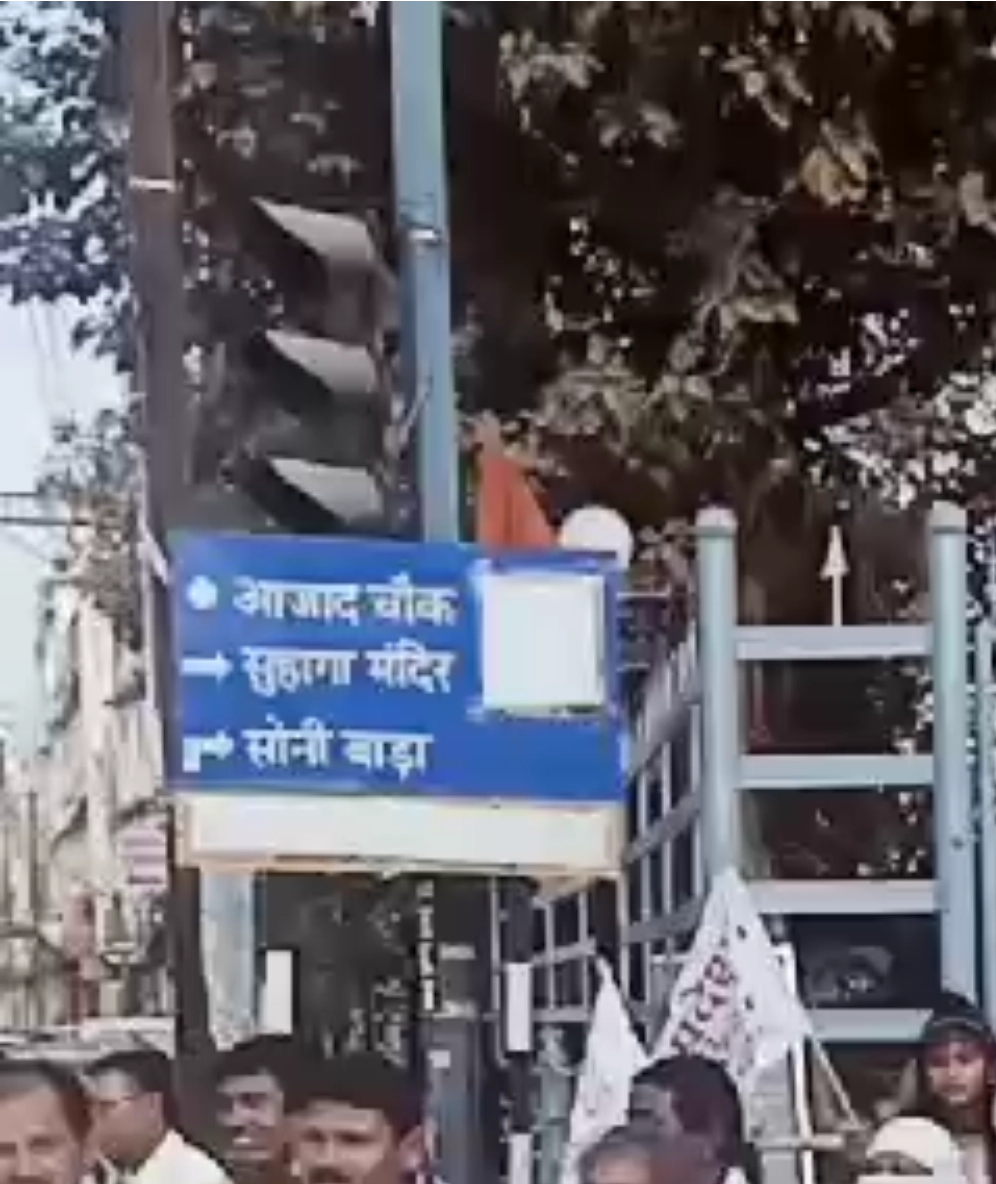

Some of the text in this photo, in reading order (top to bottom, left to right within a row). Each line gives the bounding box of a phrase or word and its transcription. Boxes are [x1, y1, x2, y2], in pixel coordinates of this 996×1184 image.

[231, 572, 457, 625] आजाद चौक
[240, 640, 454, 698] सुहागा मंदिर
[242, 715, 333, 769] सोनी
